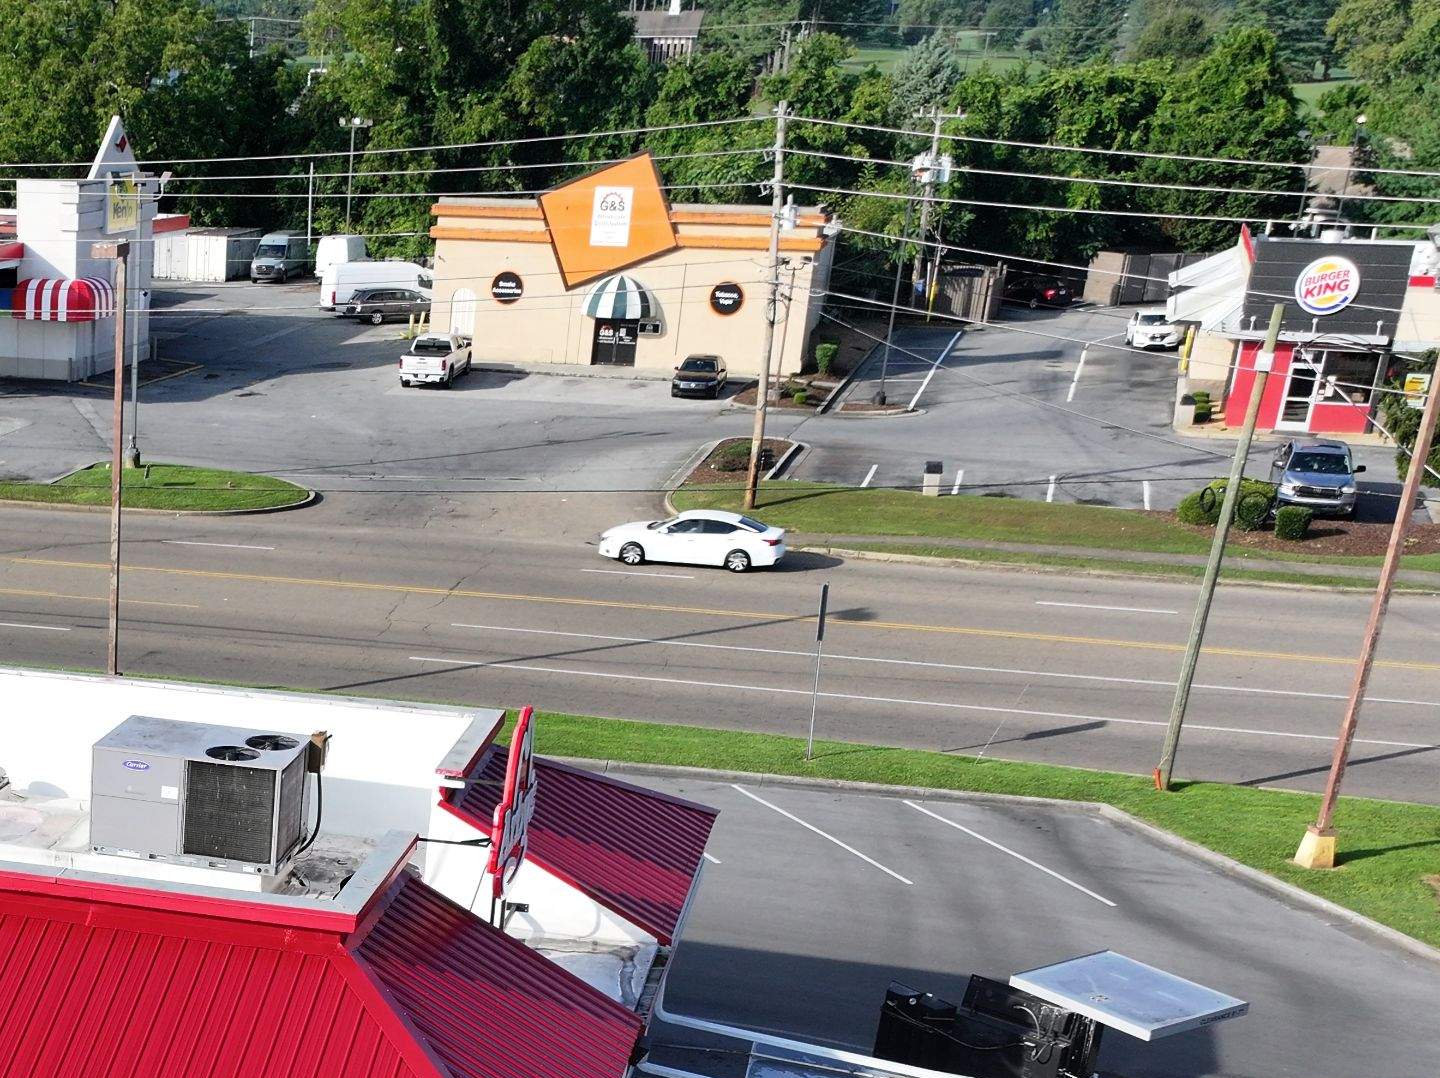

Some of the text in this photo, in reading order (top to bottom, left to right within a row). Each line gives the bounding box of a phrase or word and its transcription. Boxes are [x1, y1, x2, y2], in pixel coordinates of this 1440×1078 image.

[600, 200, 625, 211] G&S
[1304, 269, 1351, 287] BURGER
[1303, 279, 1350, 299] KING
